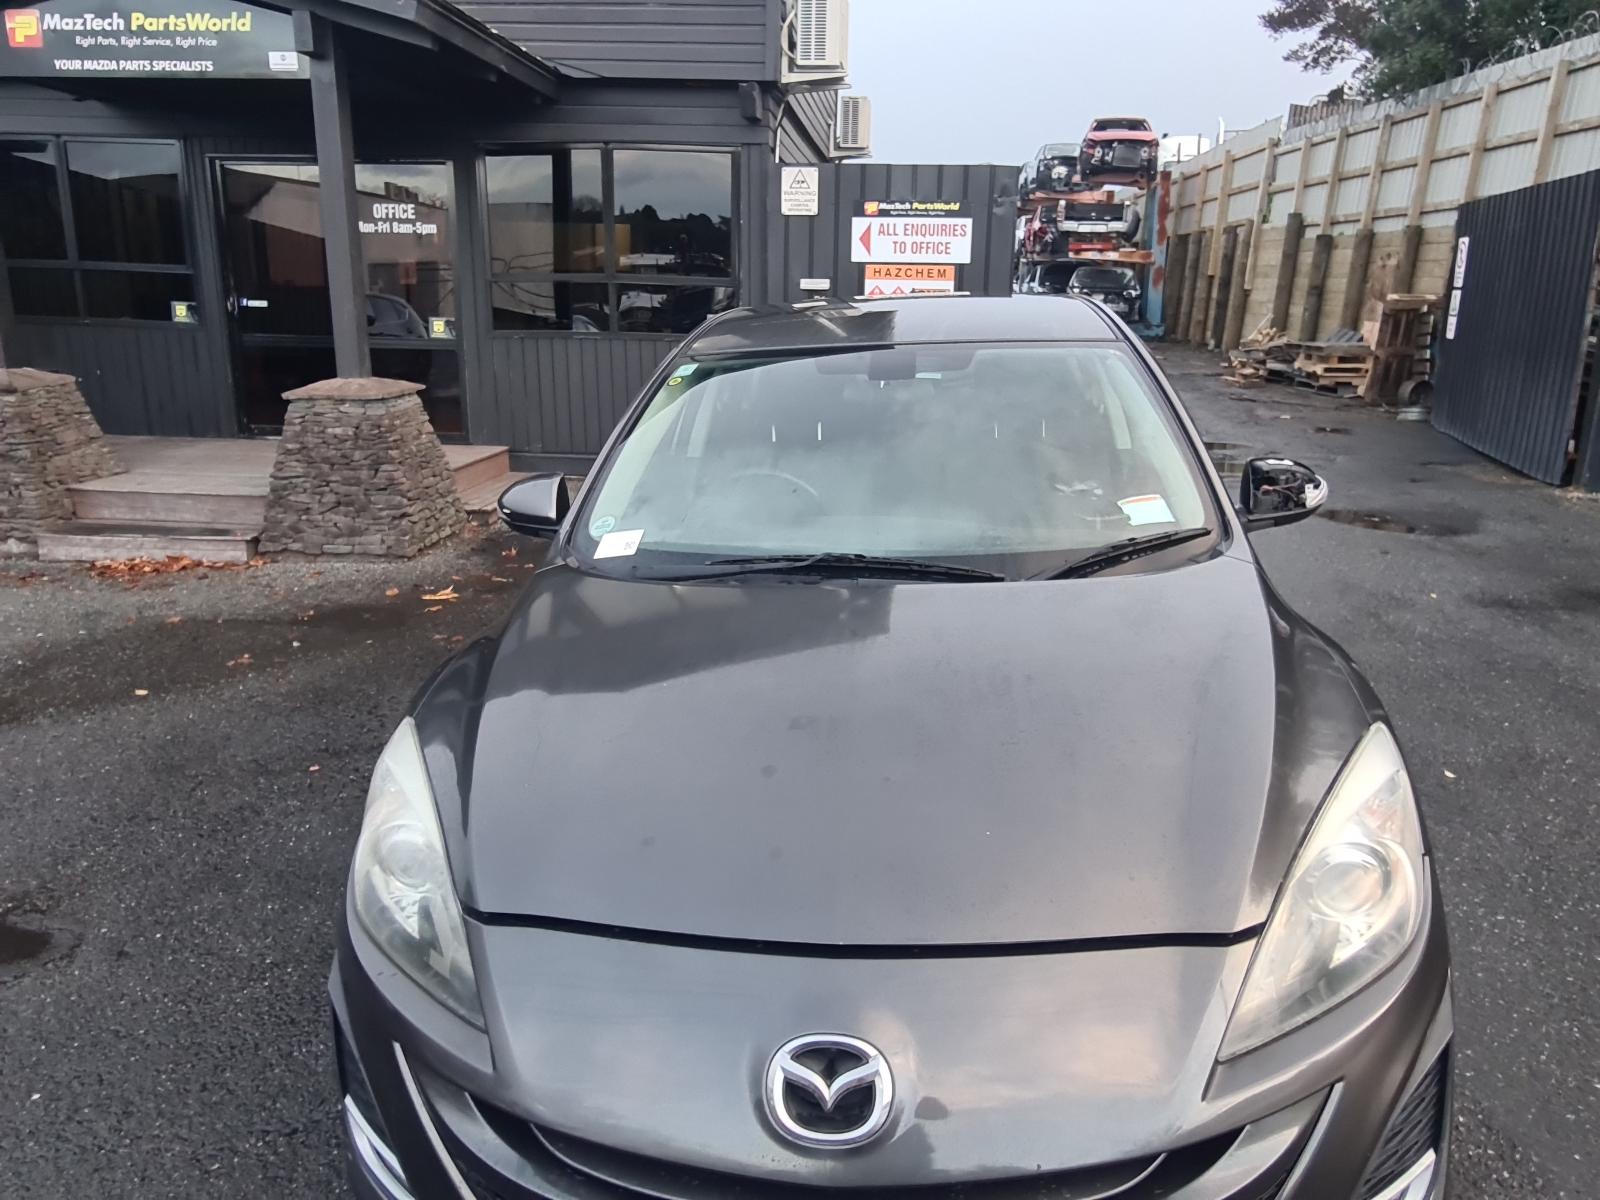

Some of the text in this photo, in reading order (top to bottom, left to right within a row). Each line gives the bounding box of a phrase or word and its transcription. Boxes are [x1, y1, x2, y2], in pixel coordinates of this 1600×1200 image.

[43, 12, 125, 30] MazTech
[131, 12, 251, 31] PartsWorld
[75, 36, 217, 48] Right Parts, Right Service, Right Price
[54, 59, 214, 72] YOUR MAZDA PARTS SPECIALISTS
[373, 203, 416, 219] OFFICE
[879, 202, 960, 211] MazTech PartsWorld
[392, 222, 437, 235] 8am-5pm
[878, 223, 967, 238] ALL ENQUIRIES
[892, 241, 951, 254] TO OFFICE
[873, 267, 947, 278] HAZCHEM
